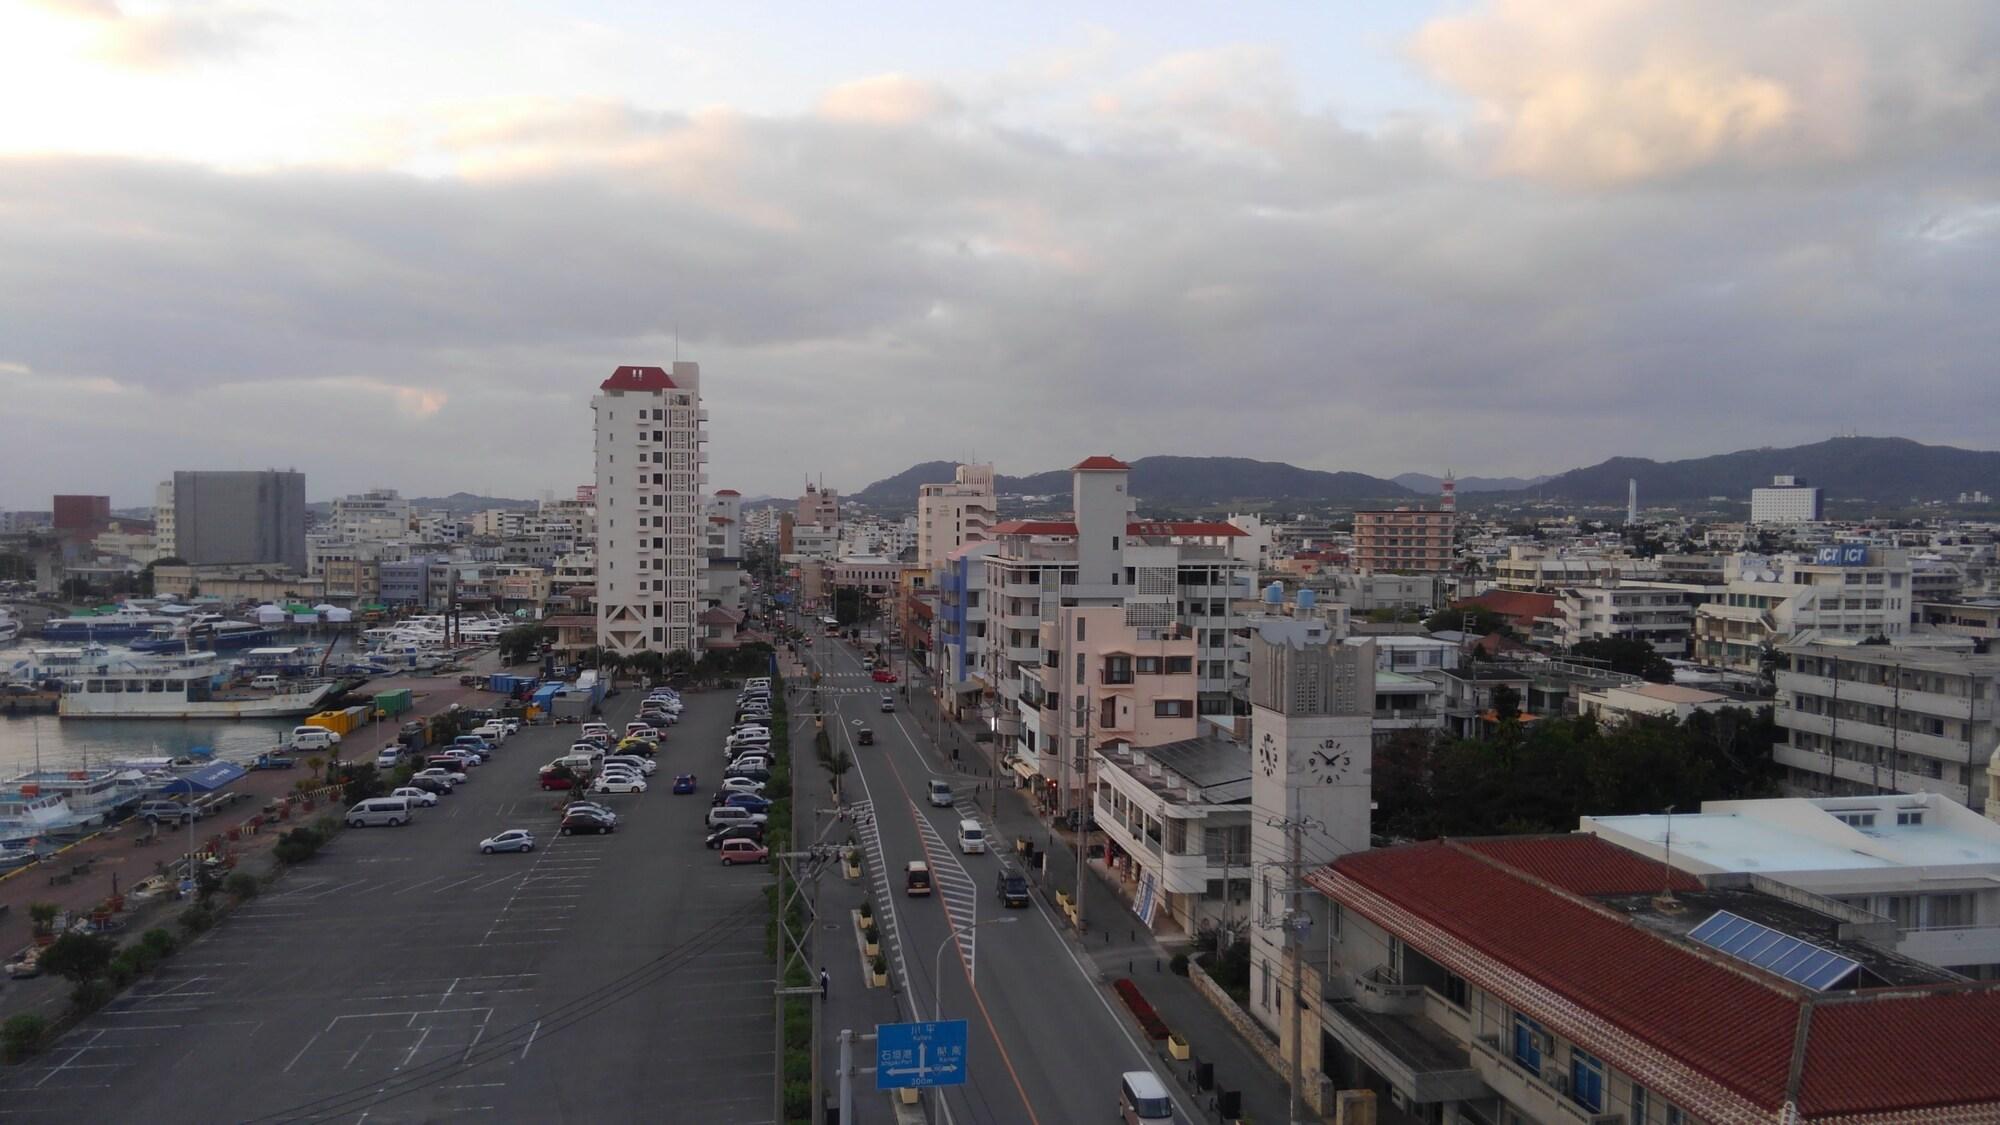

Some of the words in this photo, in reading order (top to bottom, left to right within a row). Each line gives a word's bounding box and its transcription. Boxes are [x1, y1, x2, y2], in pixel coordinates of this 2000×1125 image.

[1326, 739, 1334, 748] 12
[1309, 758, 1315, 767] 9
[1343, 757, 1350, 766] 3
[1326, 775, 1332, 784] 6
